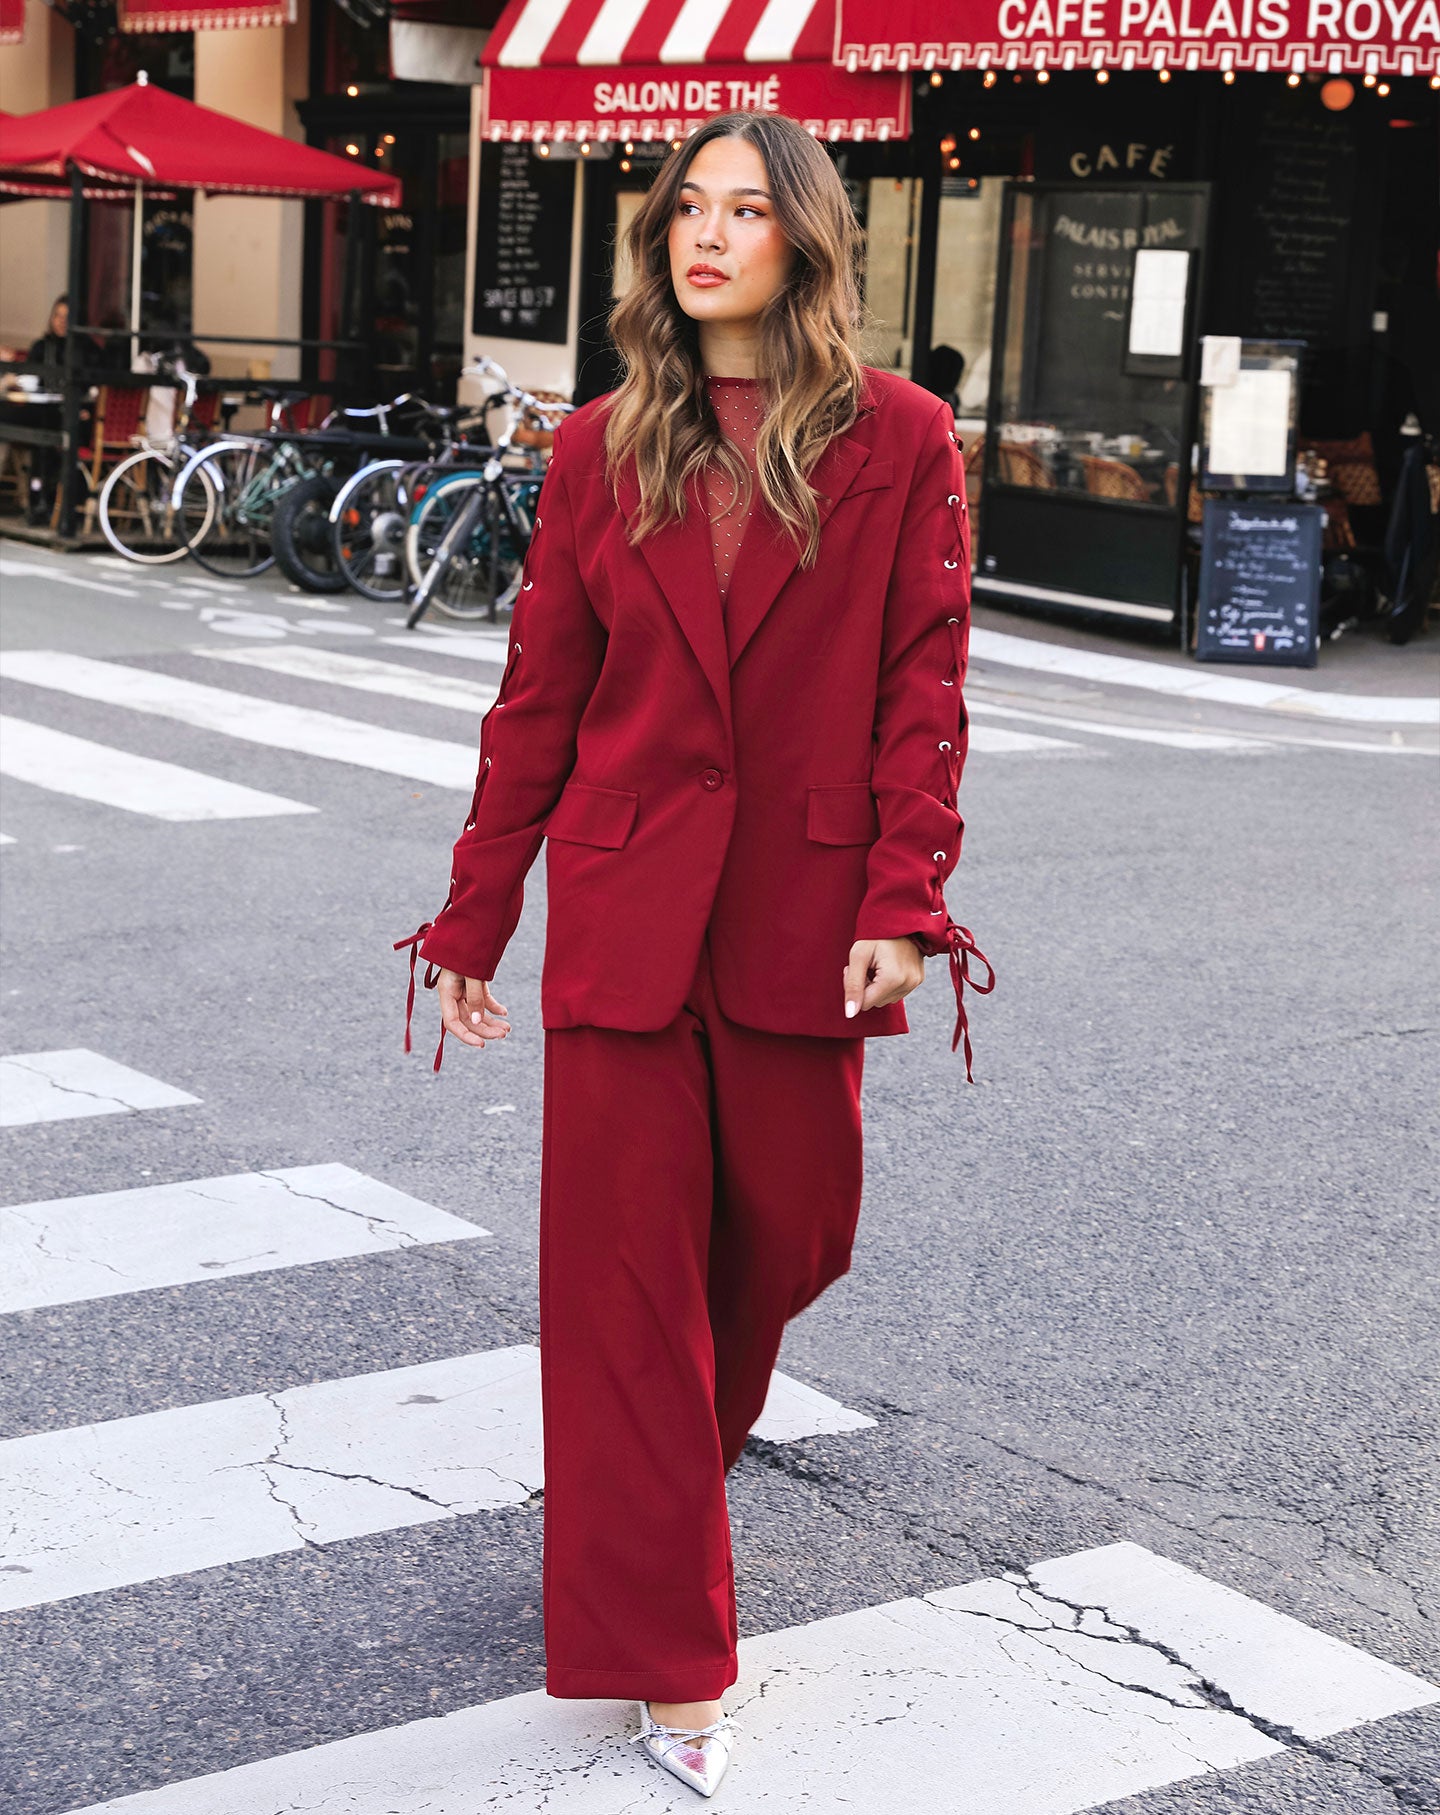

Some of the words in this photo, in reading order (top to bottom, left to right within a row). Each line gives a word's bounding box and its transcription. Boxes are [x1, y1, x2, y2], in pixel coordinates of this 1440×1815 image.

[1119, 0, 1290, 39] PALAIS
[593, 81, 680, 114] SALON
[684, 80, 723, 112] DE
[725, 74, 781, 112] THÉ
[1069, 143, 1174, 178] CAFÉ
[1054, 215, 1121, 250] PALAIS
[1123, 218, 1185, 249] RYAL
